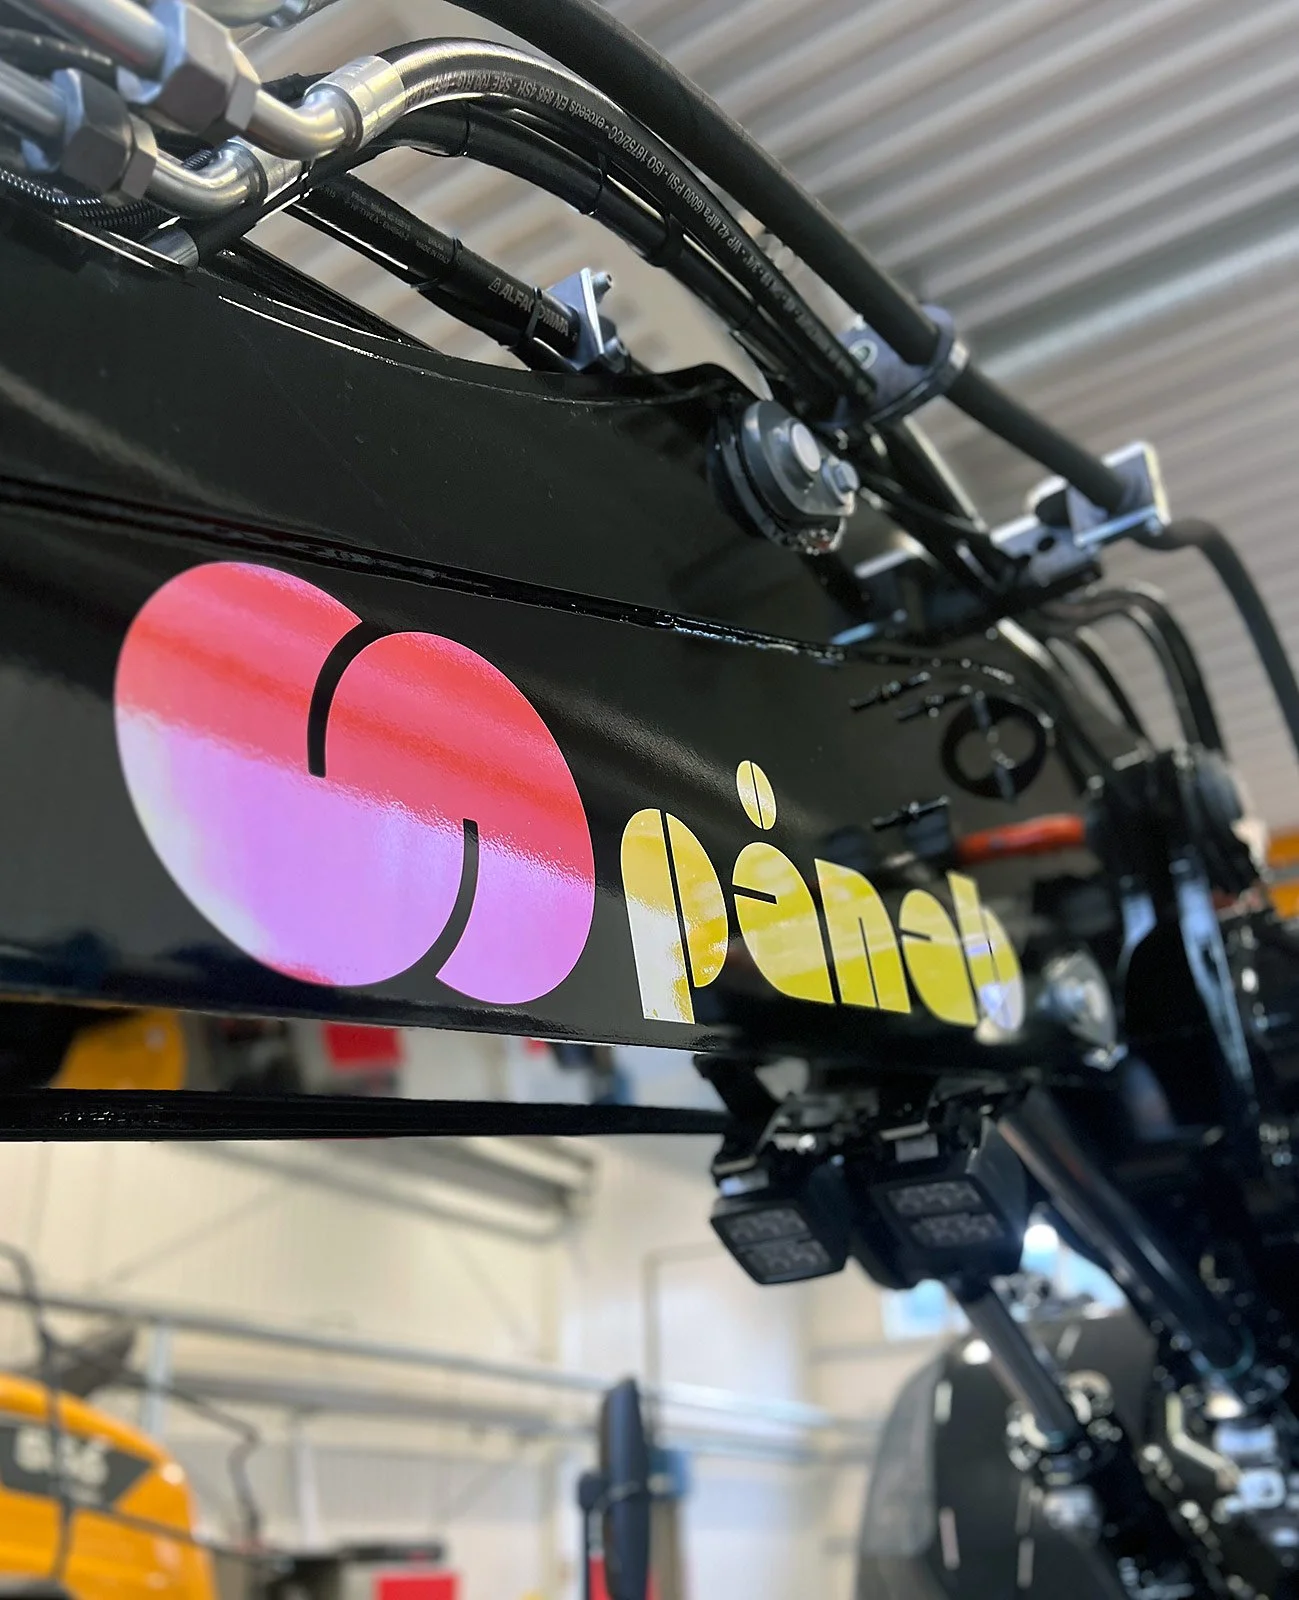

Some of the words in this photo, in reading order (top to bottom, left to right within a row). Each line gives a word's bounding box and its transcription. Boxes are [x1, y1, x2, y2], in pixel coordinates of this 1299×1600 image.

[492, 75, 513, 92] SAE
[517, 80, 537, 98] 4SH
[536, 86, 555, 104] 856
[552, 93, 569, 111] EN
[568, 100, 606, 129] exceeds
[608, 125, 649, 162] 18752/CC
[646, 156, 665, 176] ISO
[666, 172, 686, 195] PSI)
[682, 187, 705, 214] (6000
[703, 206, 721, 230] MPa
[718, 223, 730, 239] 42
[727, 236, 742, 254] WP
